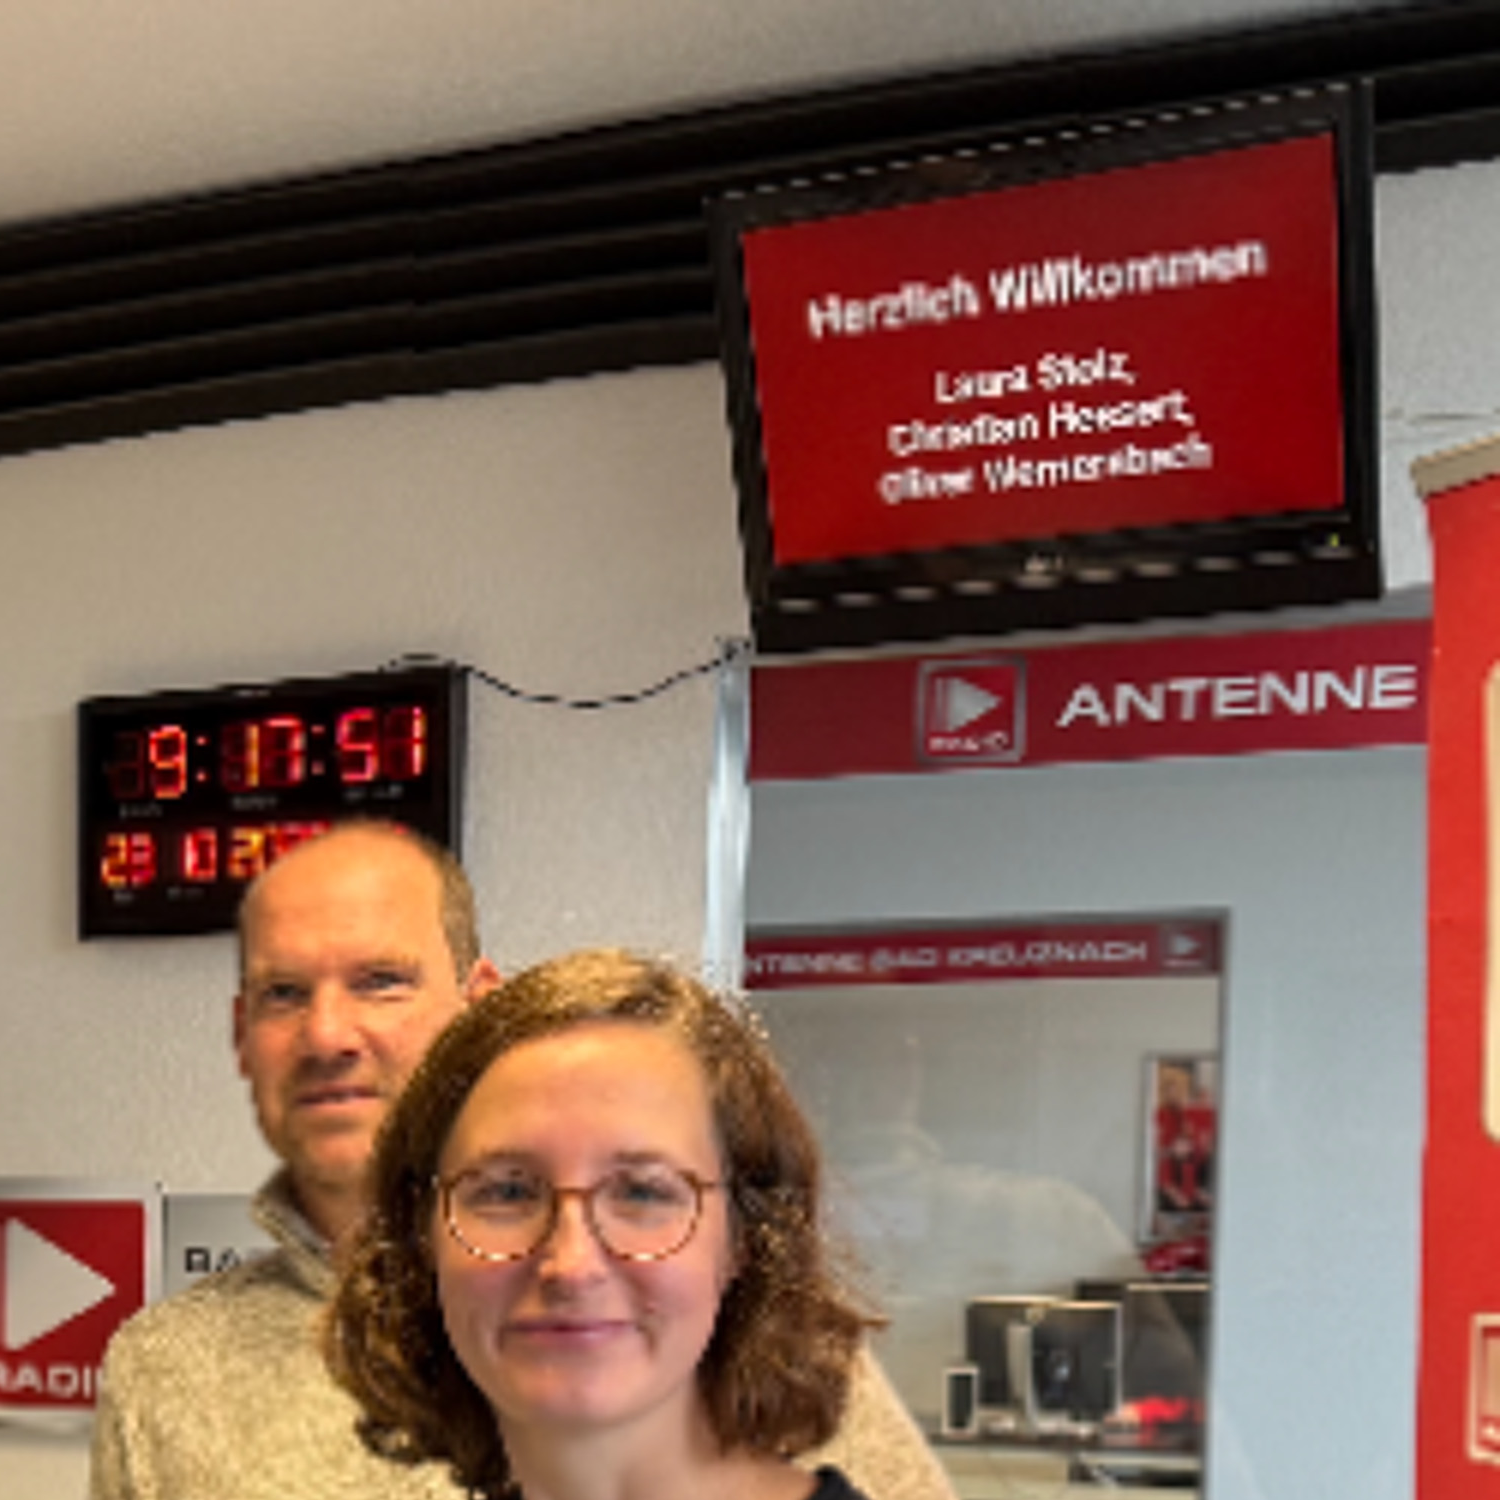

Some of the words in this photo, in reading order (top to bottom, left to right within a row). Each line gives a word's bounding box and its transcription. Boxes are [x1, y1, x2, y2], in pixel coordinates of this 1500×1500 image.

[808, 272, 981, 338] Herzlich
[989, 239, 1268, 311] Willkommen
[934, 364, 1029, 403] Laura
[1056, 664, 1418, 727] ANTENNE
